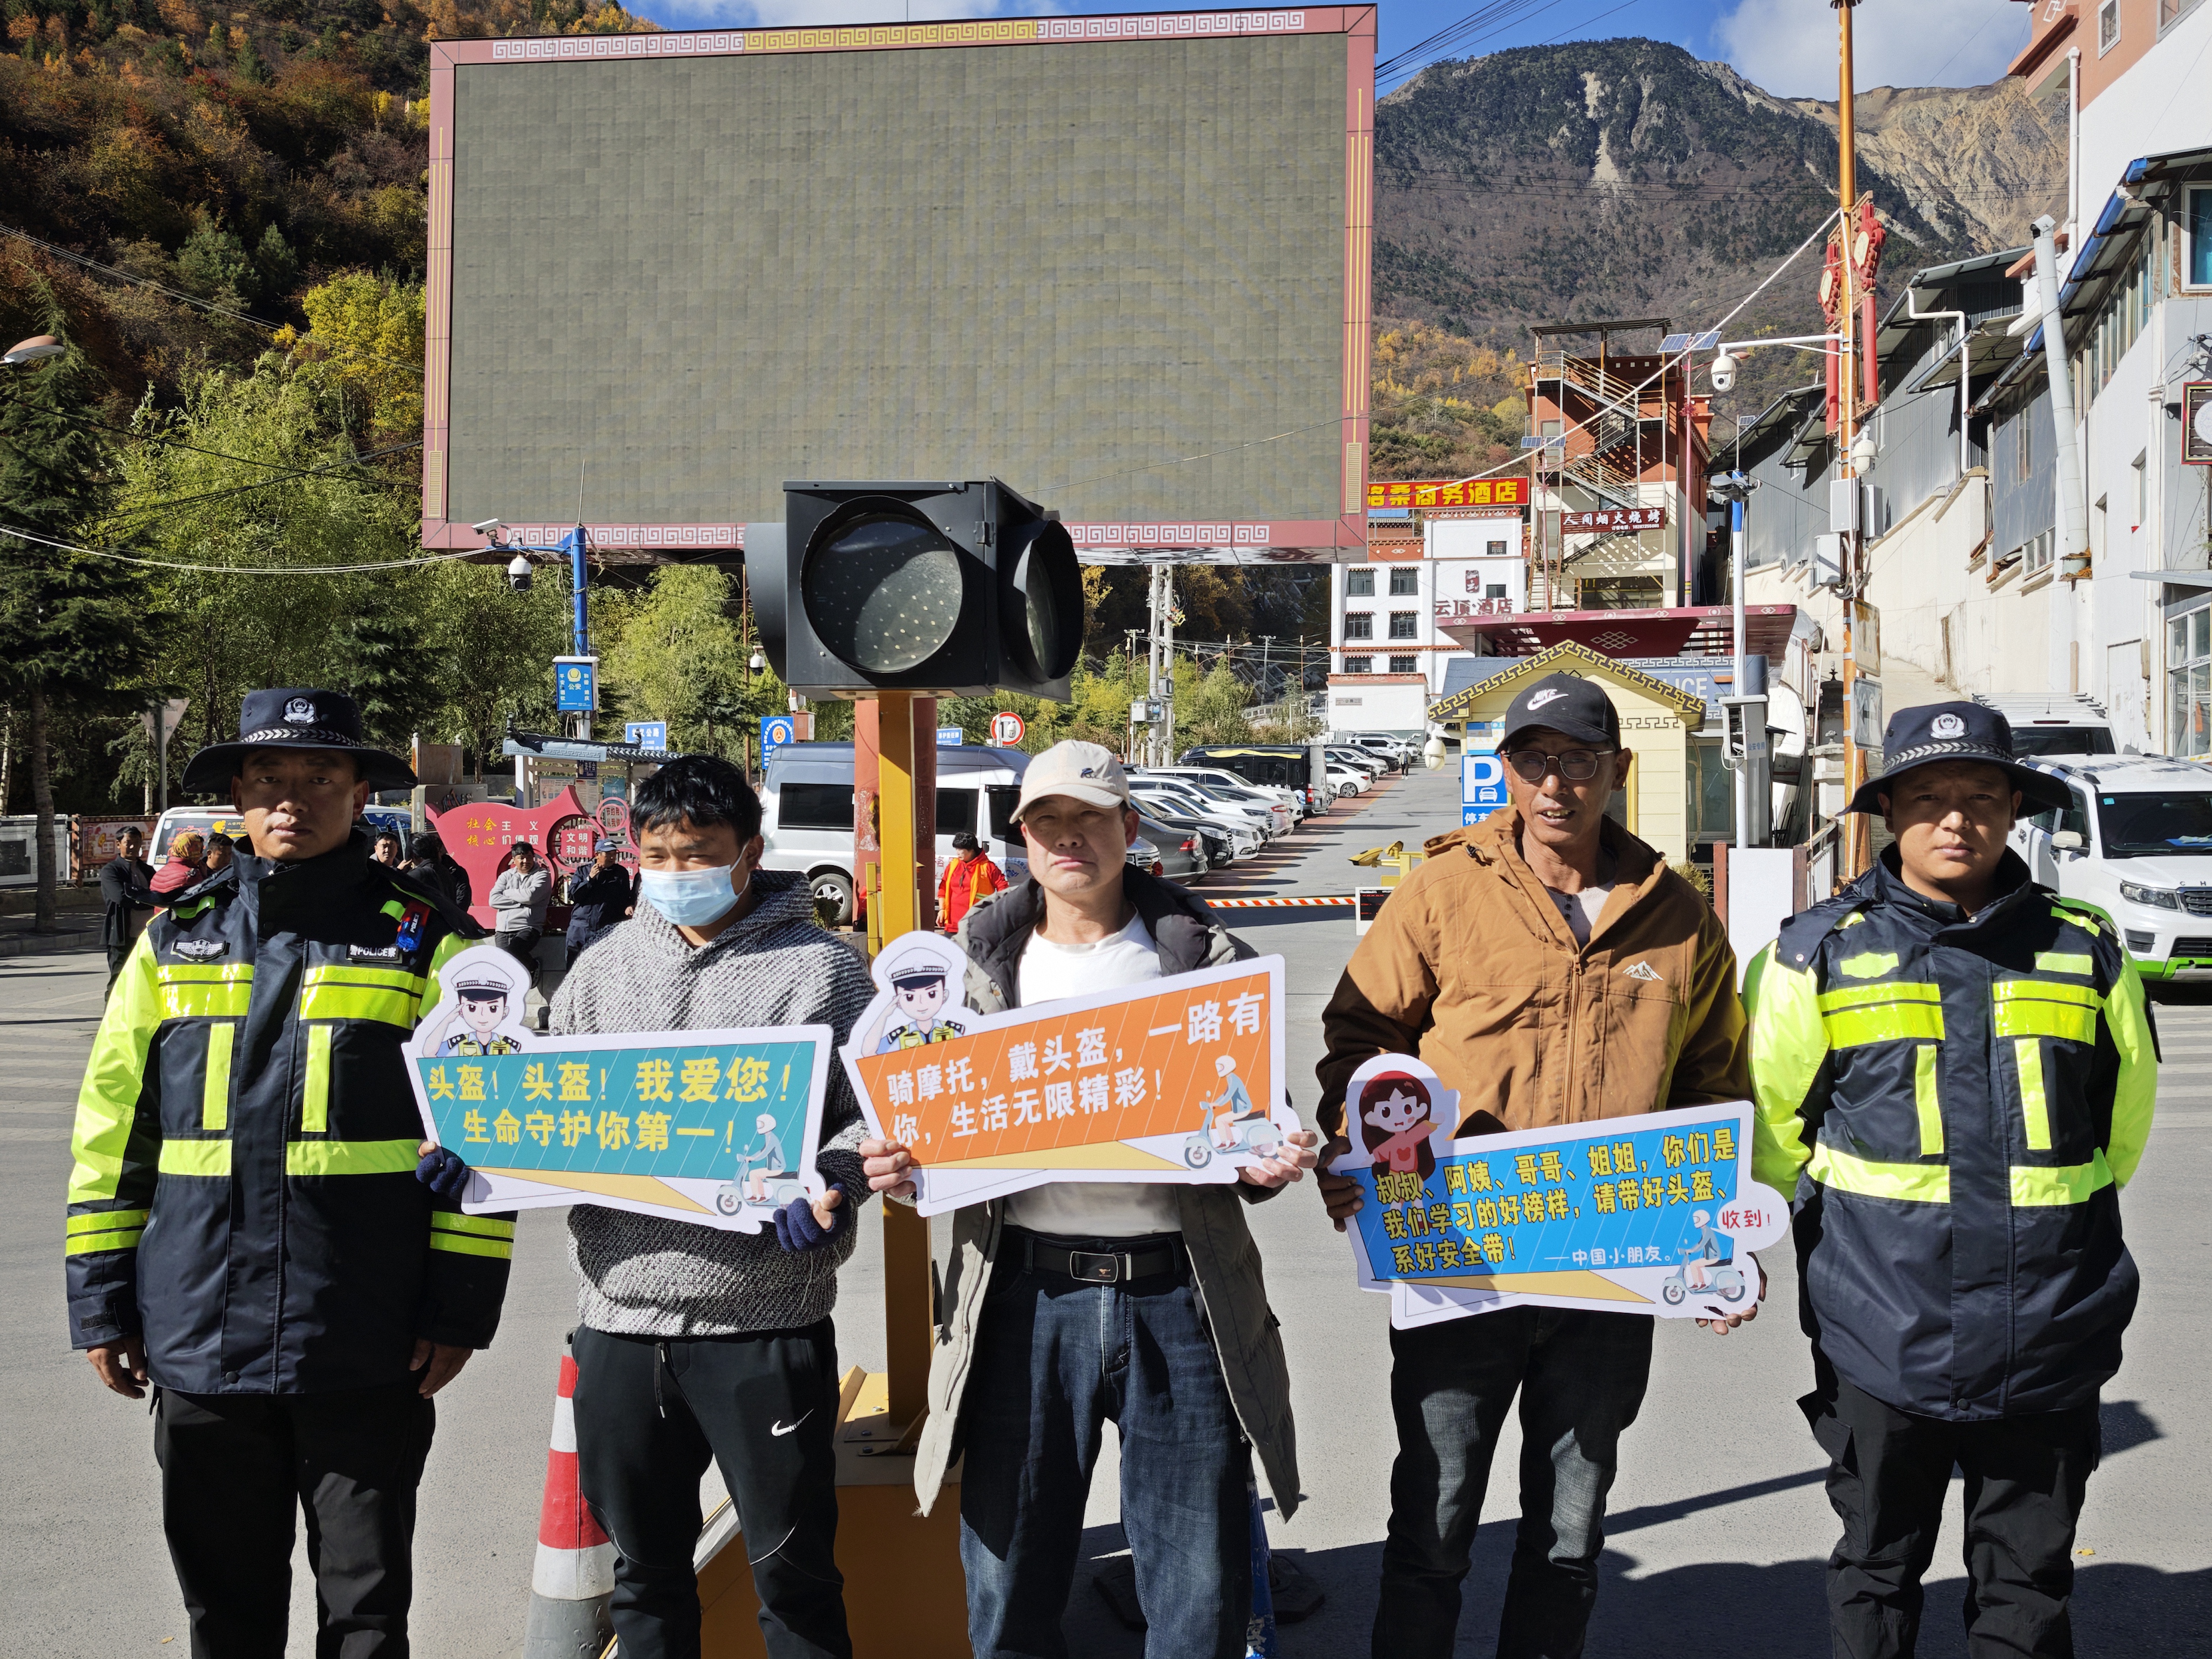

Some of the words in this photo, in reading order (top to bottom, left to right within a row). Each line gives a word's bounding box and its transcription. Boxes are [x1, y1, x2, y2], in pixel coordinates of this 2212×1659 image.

[1563, 509, 1661, 527] 人间烟火烧烤
[1533, 689, 1557, 703] NIKE
[1463, 756, 1503, 802] P
[466, 834, 539, 847] 核心价值观
[566, 832, 588, 843] 文明
[566, 845, 588, 857] 和谐
[410, 913, 420, 933] POLICE
[463, 1108, 734, 1155] 生命守护你第一！
[1721, 1209, 1771, 1230] 收到！
[1391, 1232, 1515, 1274] 系好安全带！
